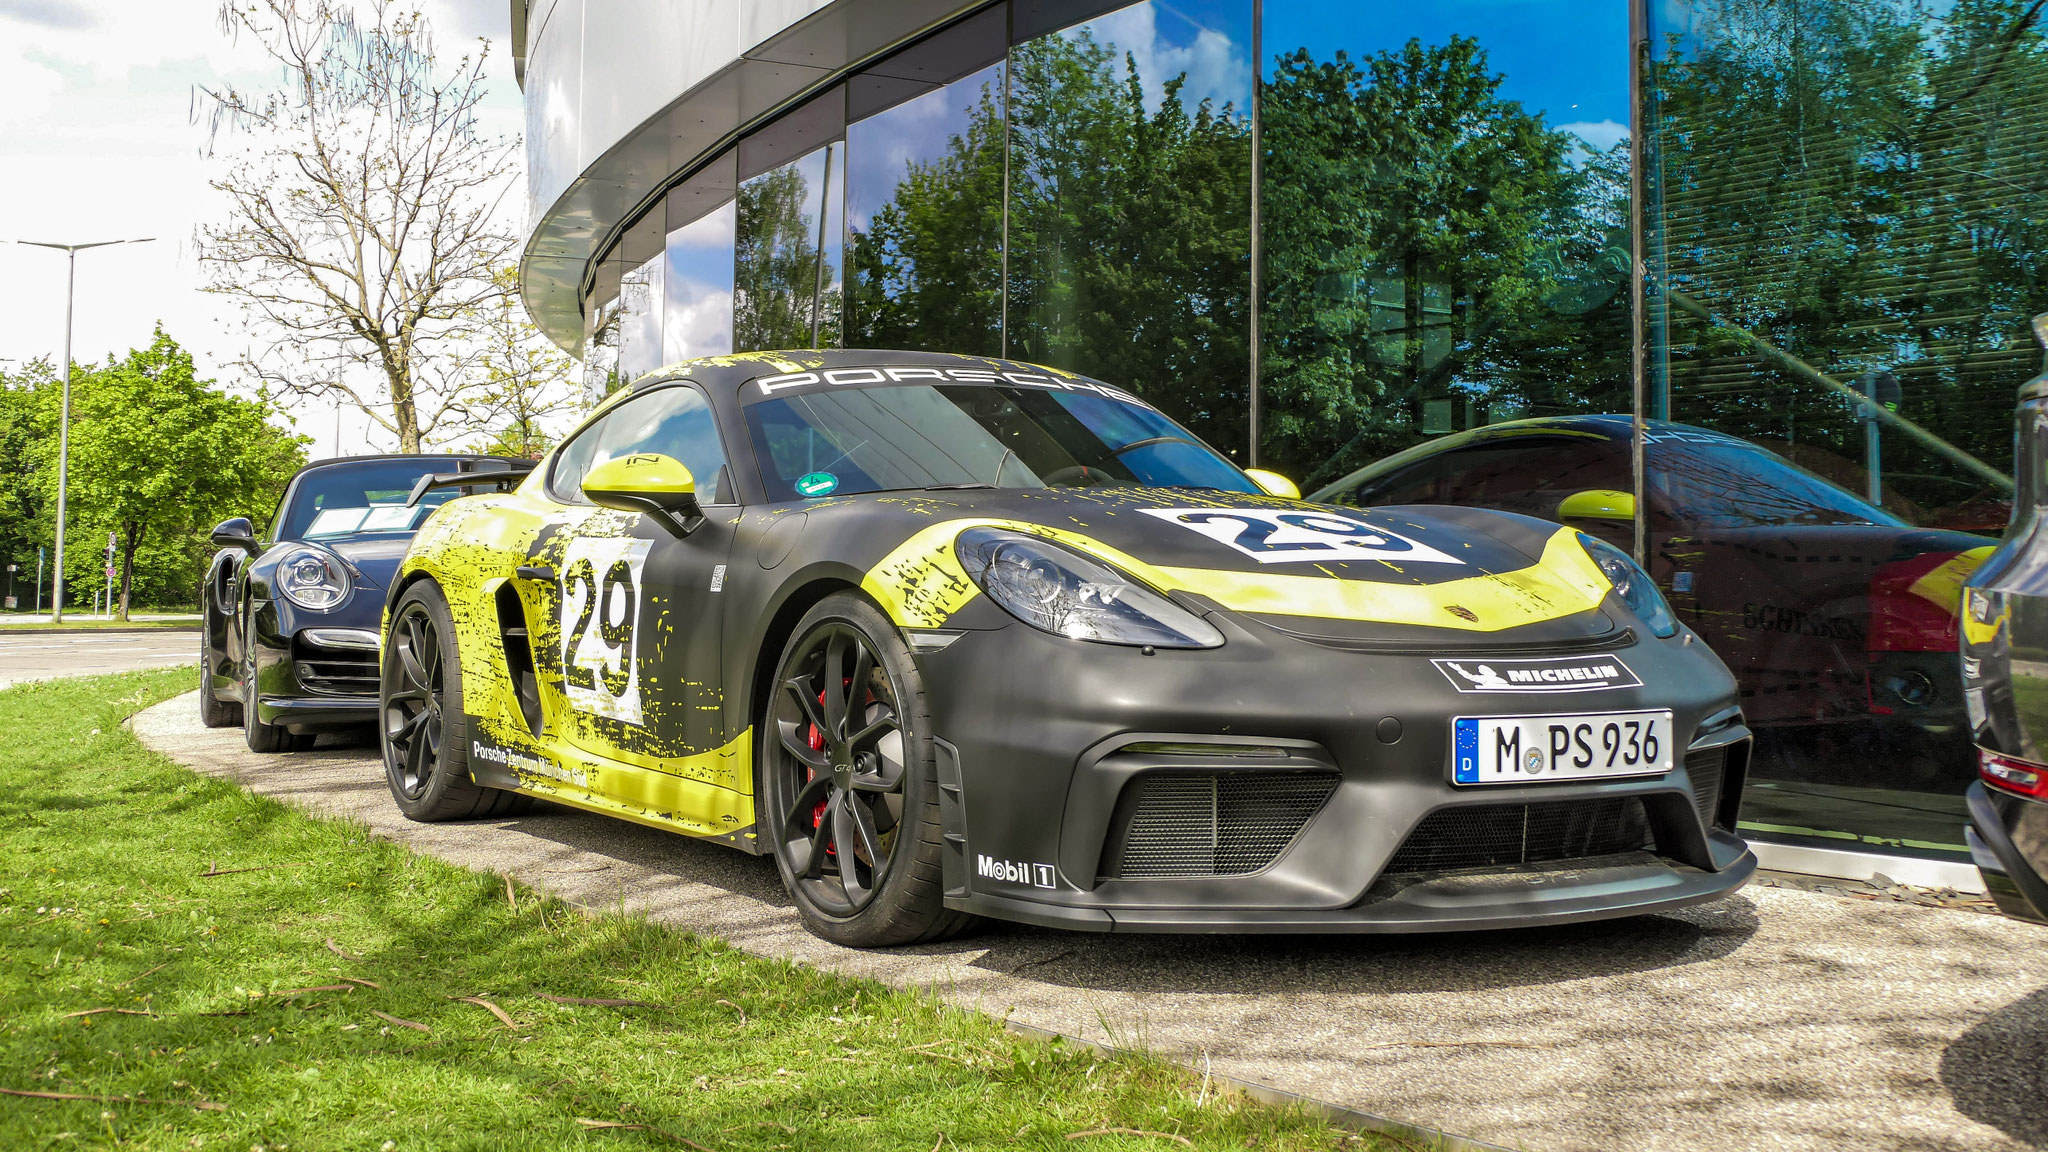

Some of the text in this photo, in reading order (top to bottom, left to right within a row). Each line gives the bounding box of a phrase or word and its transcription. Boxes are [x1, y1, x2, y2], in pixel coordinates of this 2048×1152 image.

[756, 368, 1153, 411] PORSCHE
[1176, 512, 1413, 552] 29
[564, 558, 636, 698] 29
[1506, 665, 1620, 683] MICHELIN
[473, 741, 507, 764] Porsche
[506, 748, 539, 774] Zentrum
[1462, 757, 1472, 771] D
[1495, 726, 1520, 773] M
[977, 853, 1030, 884] Mobil
